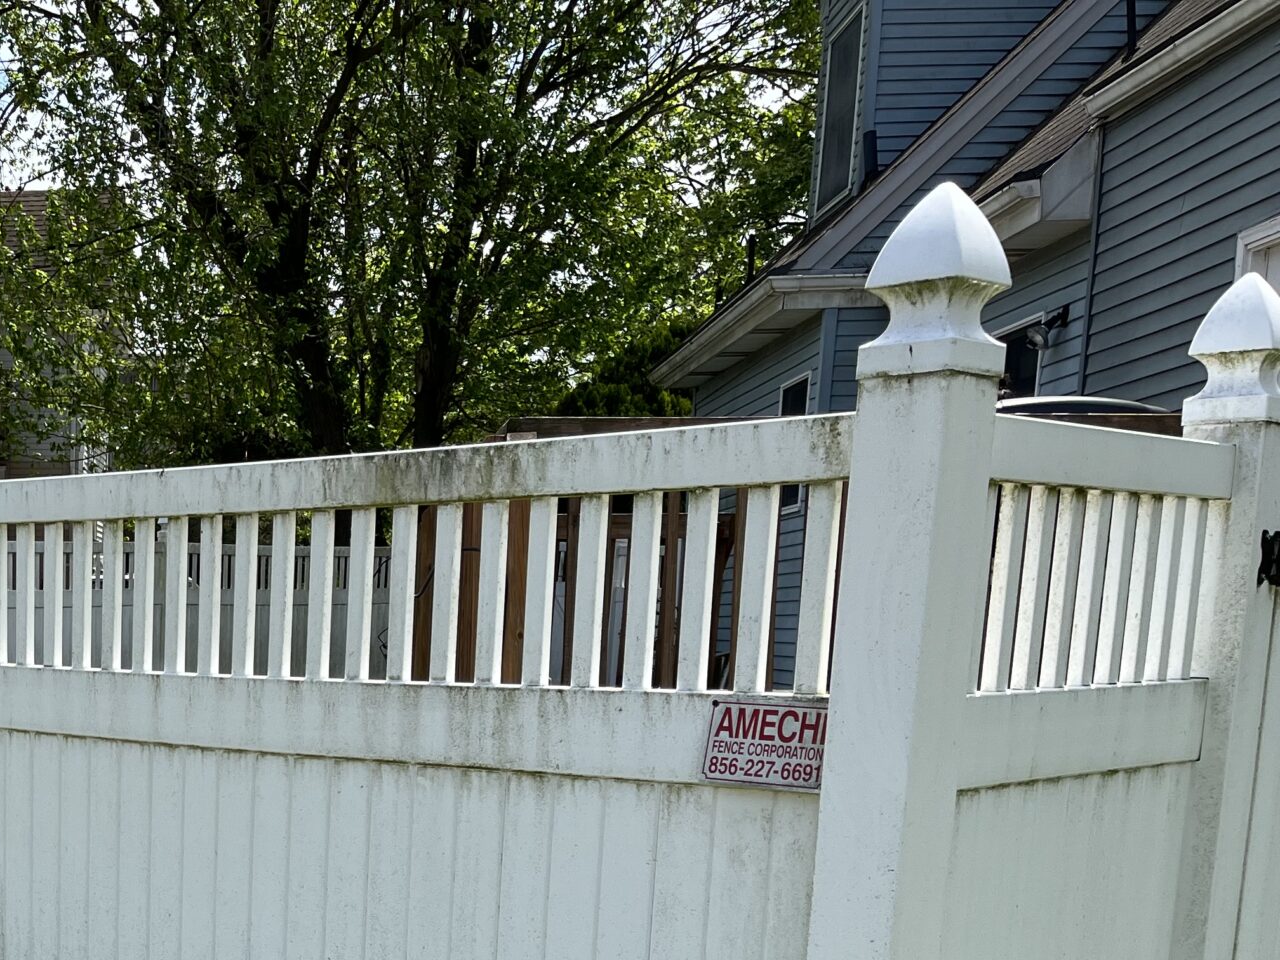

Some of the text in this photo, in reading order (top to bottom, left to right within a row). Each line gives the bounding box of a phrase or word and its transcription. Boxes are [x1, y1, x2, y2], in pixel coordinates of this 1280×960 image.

[711, 740, 824, 761] FENCE CORPORATION
[708, 756, 821, 783] 856-227-6691
